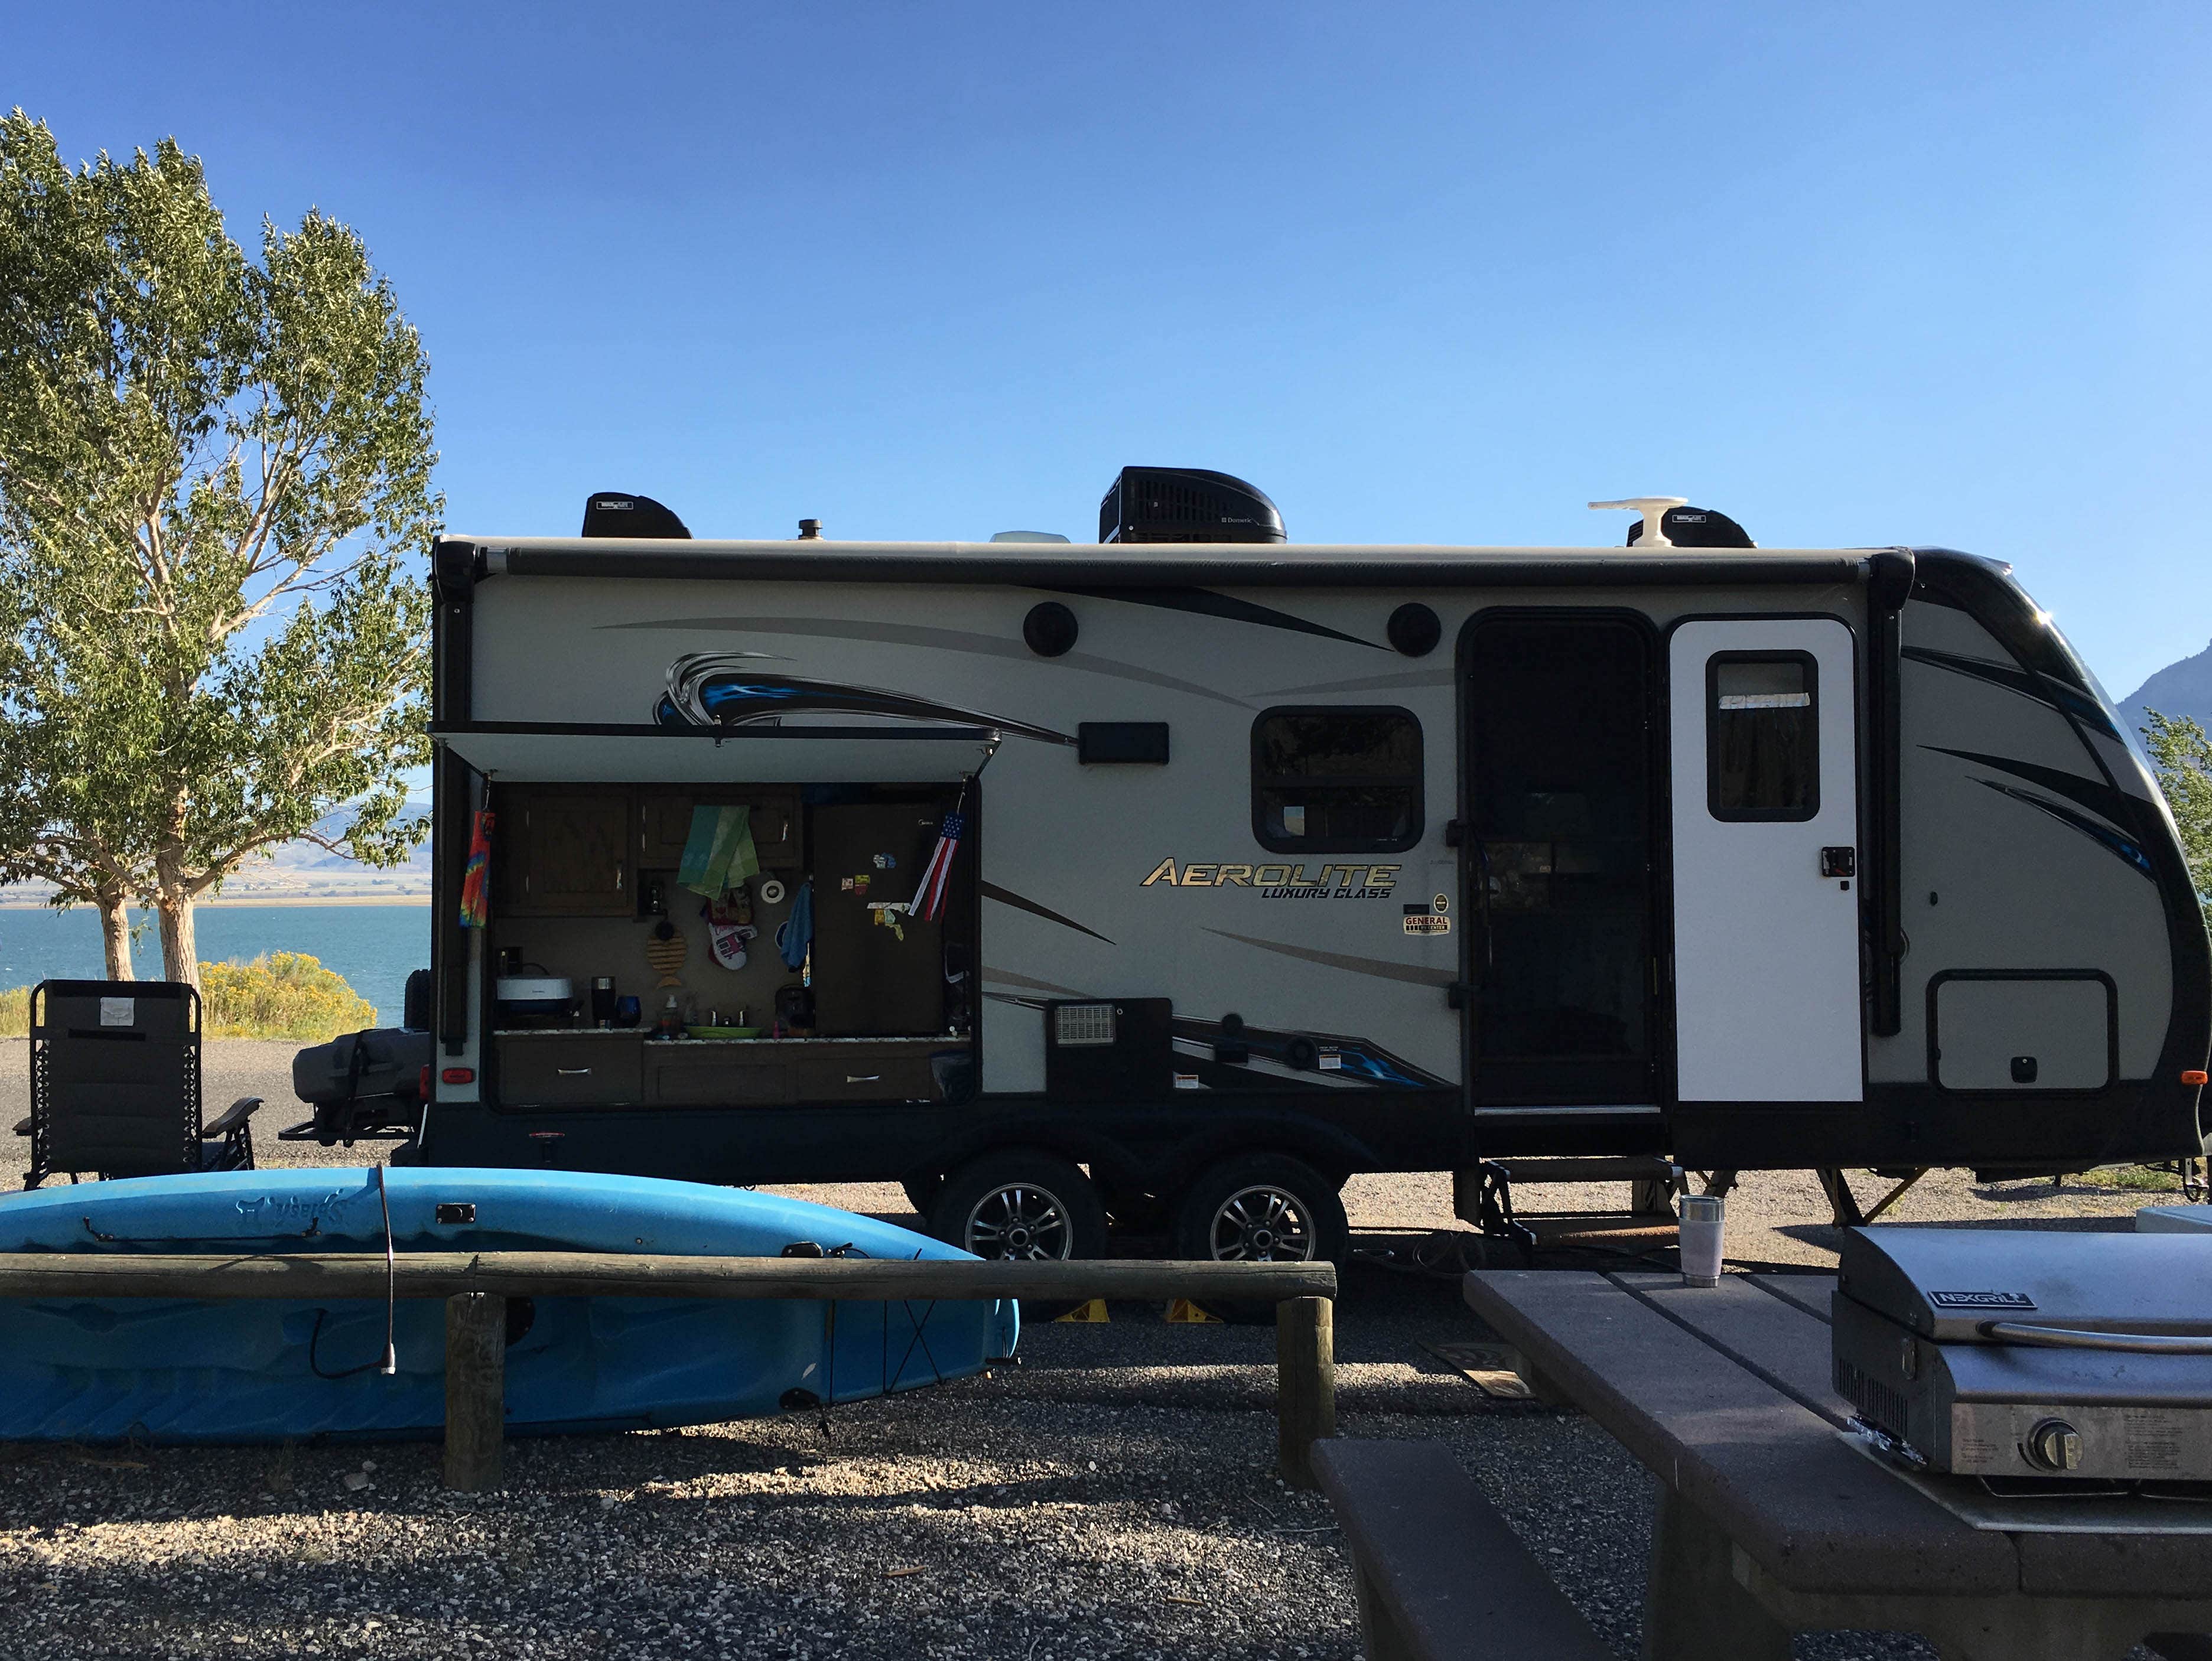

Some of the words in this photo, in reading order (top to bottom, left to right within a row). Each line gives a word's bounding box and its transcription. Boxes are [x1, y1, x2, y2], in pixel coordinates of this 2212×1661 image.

[1140, 857, 1402, 887] AEROLITE
[1261, 888, 1329, 898] LUXURY
[1333, 888, 1391, 898] CLASS
[1406, 917, 1447, 925] GENERAL
